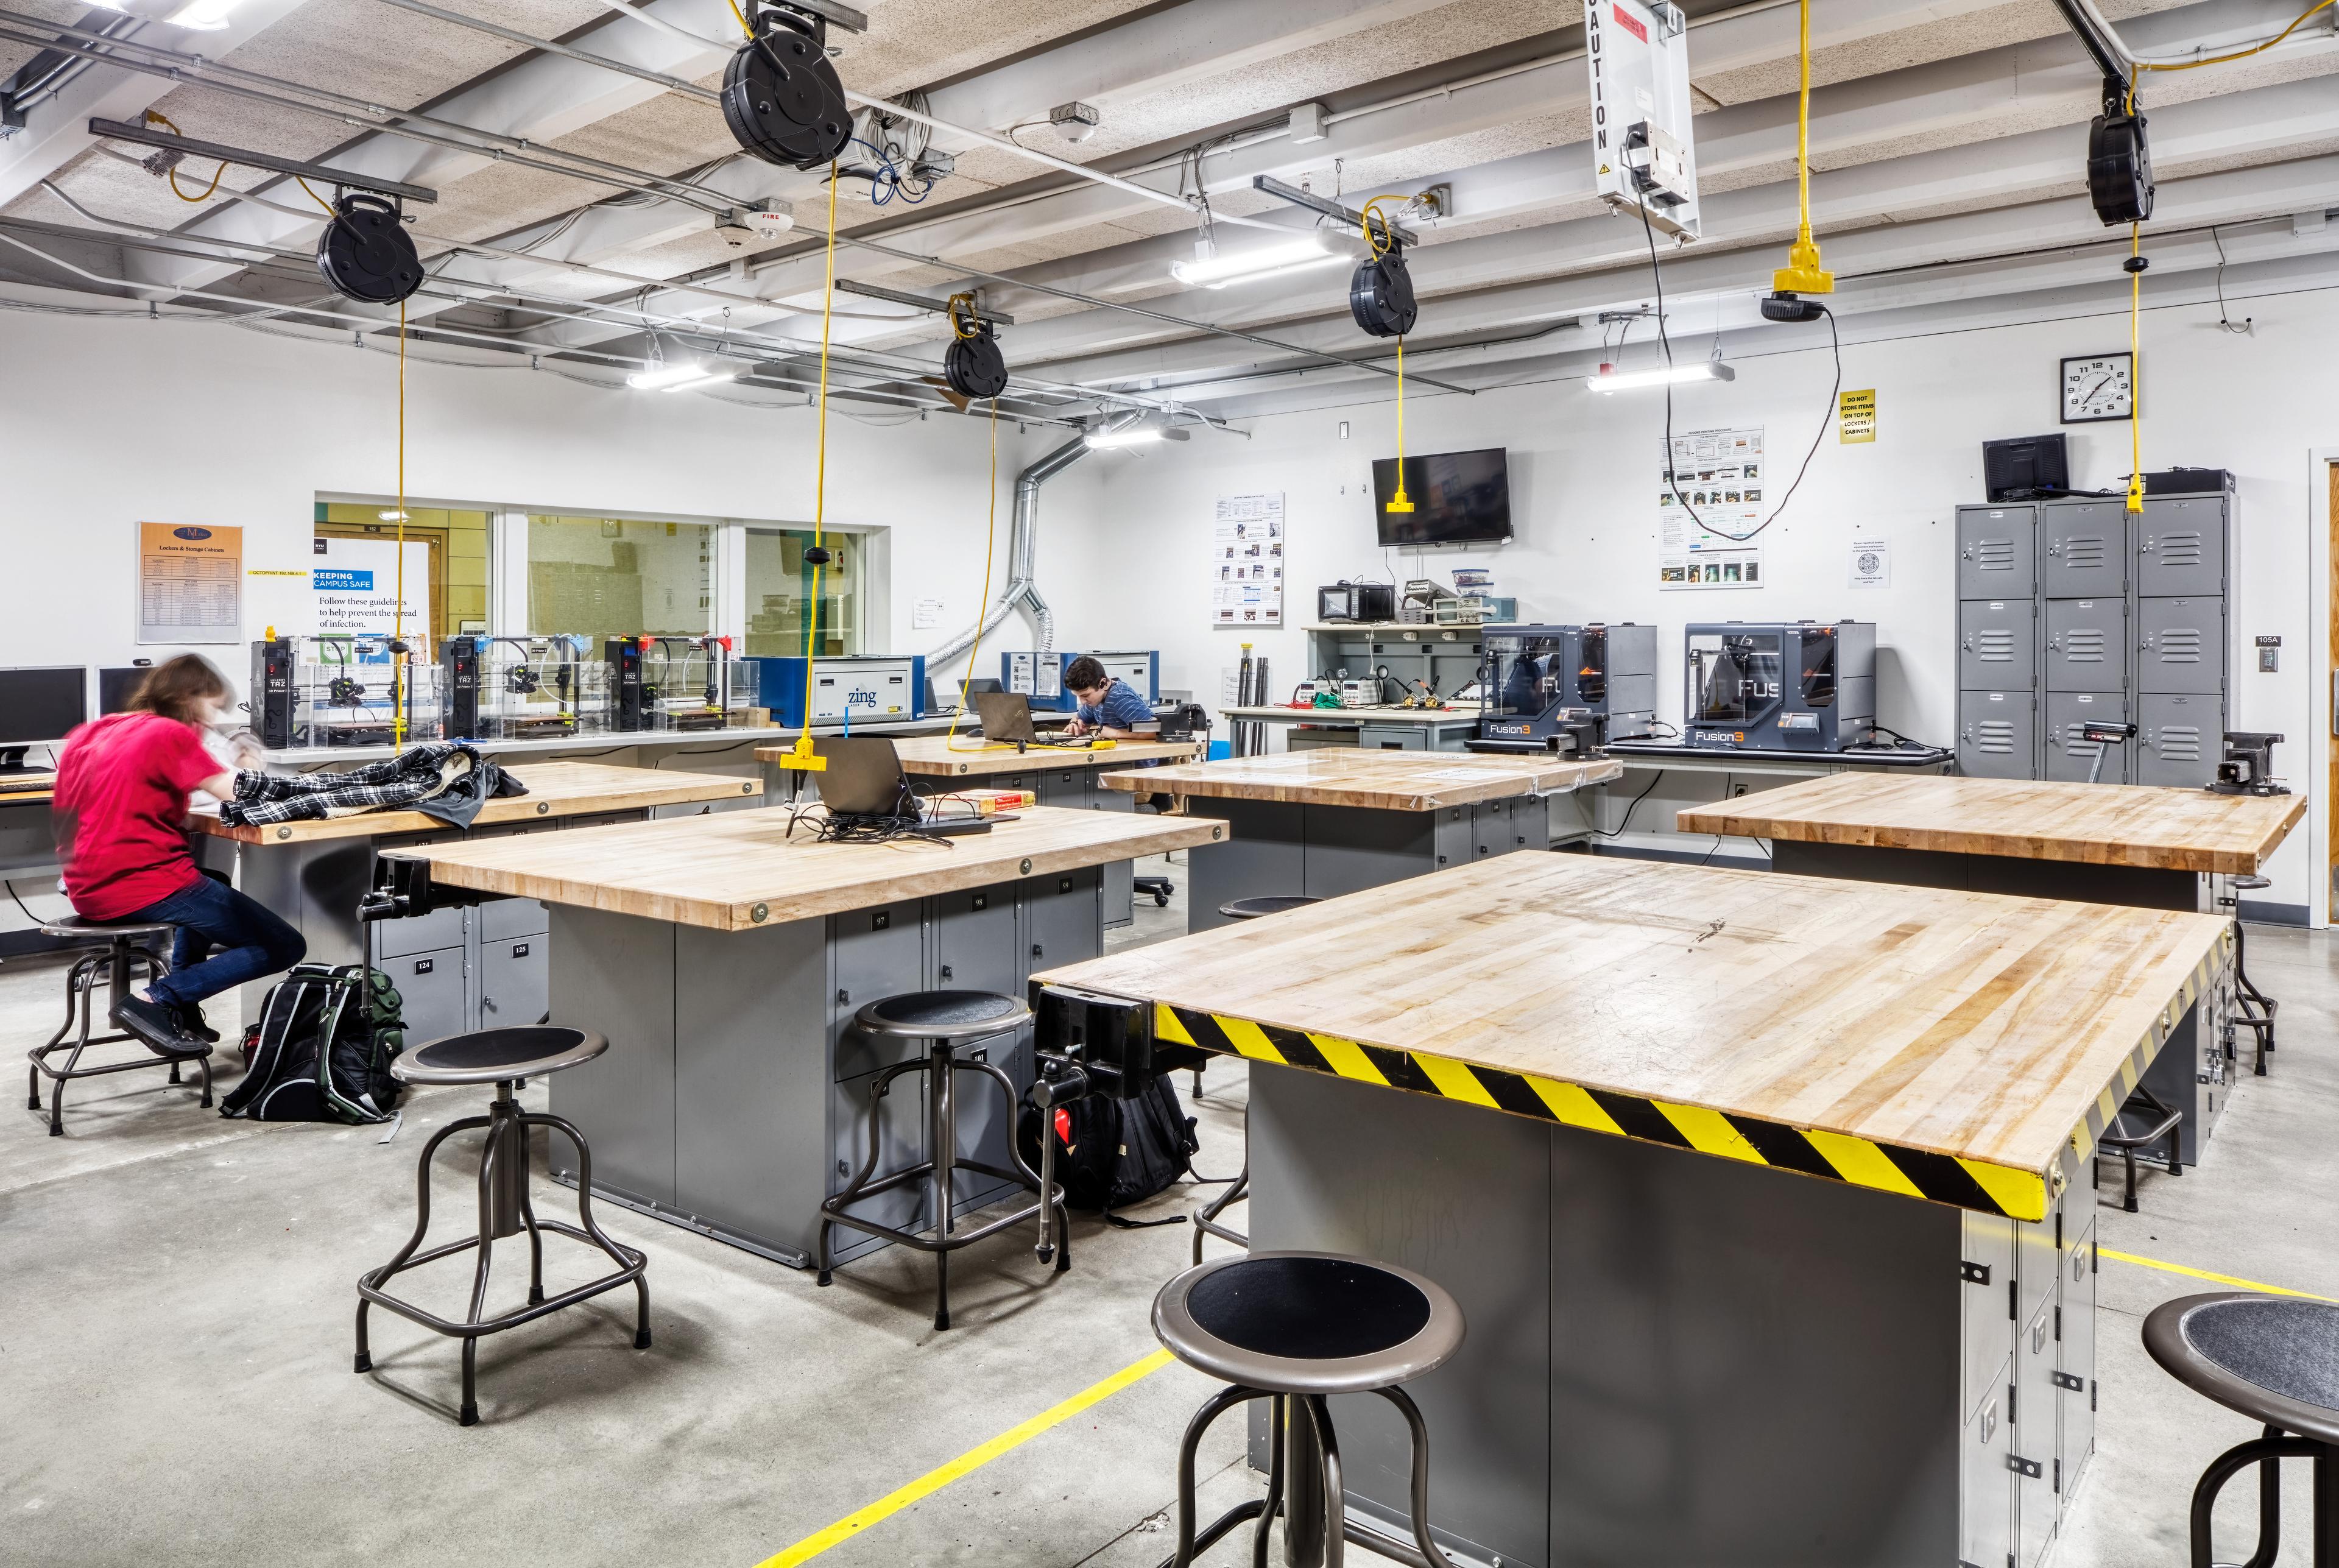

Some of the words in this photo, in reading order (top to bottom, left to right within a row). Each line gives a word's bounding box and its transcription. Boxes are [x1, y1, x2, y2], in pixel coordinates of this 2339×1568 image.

[329, 609, 347, 618] help
[848, 688, 877, 708] zing
[1491, 724, 1531, 735] Fusion3
[1696, 731, 1744, 741] Fusion3
